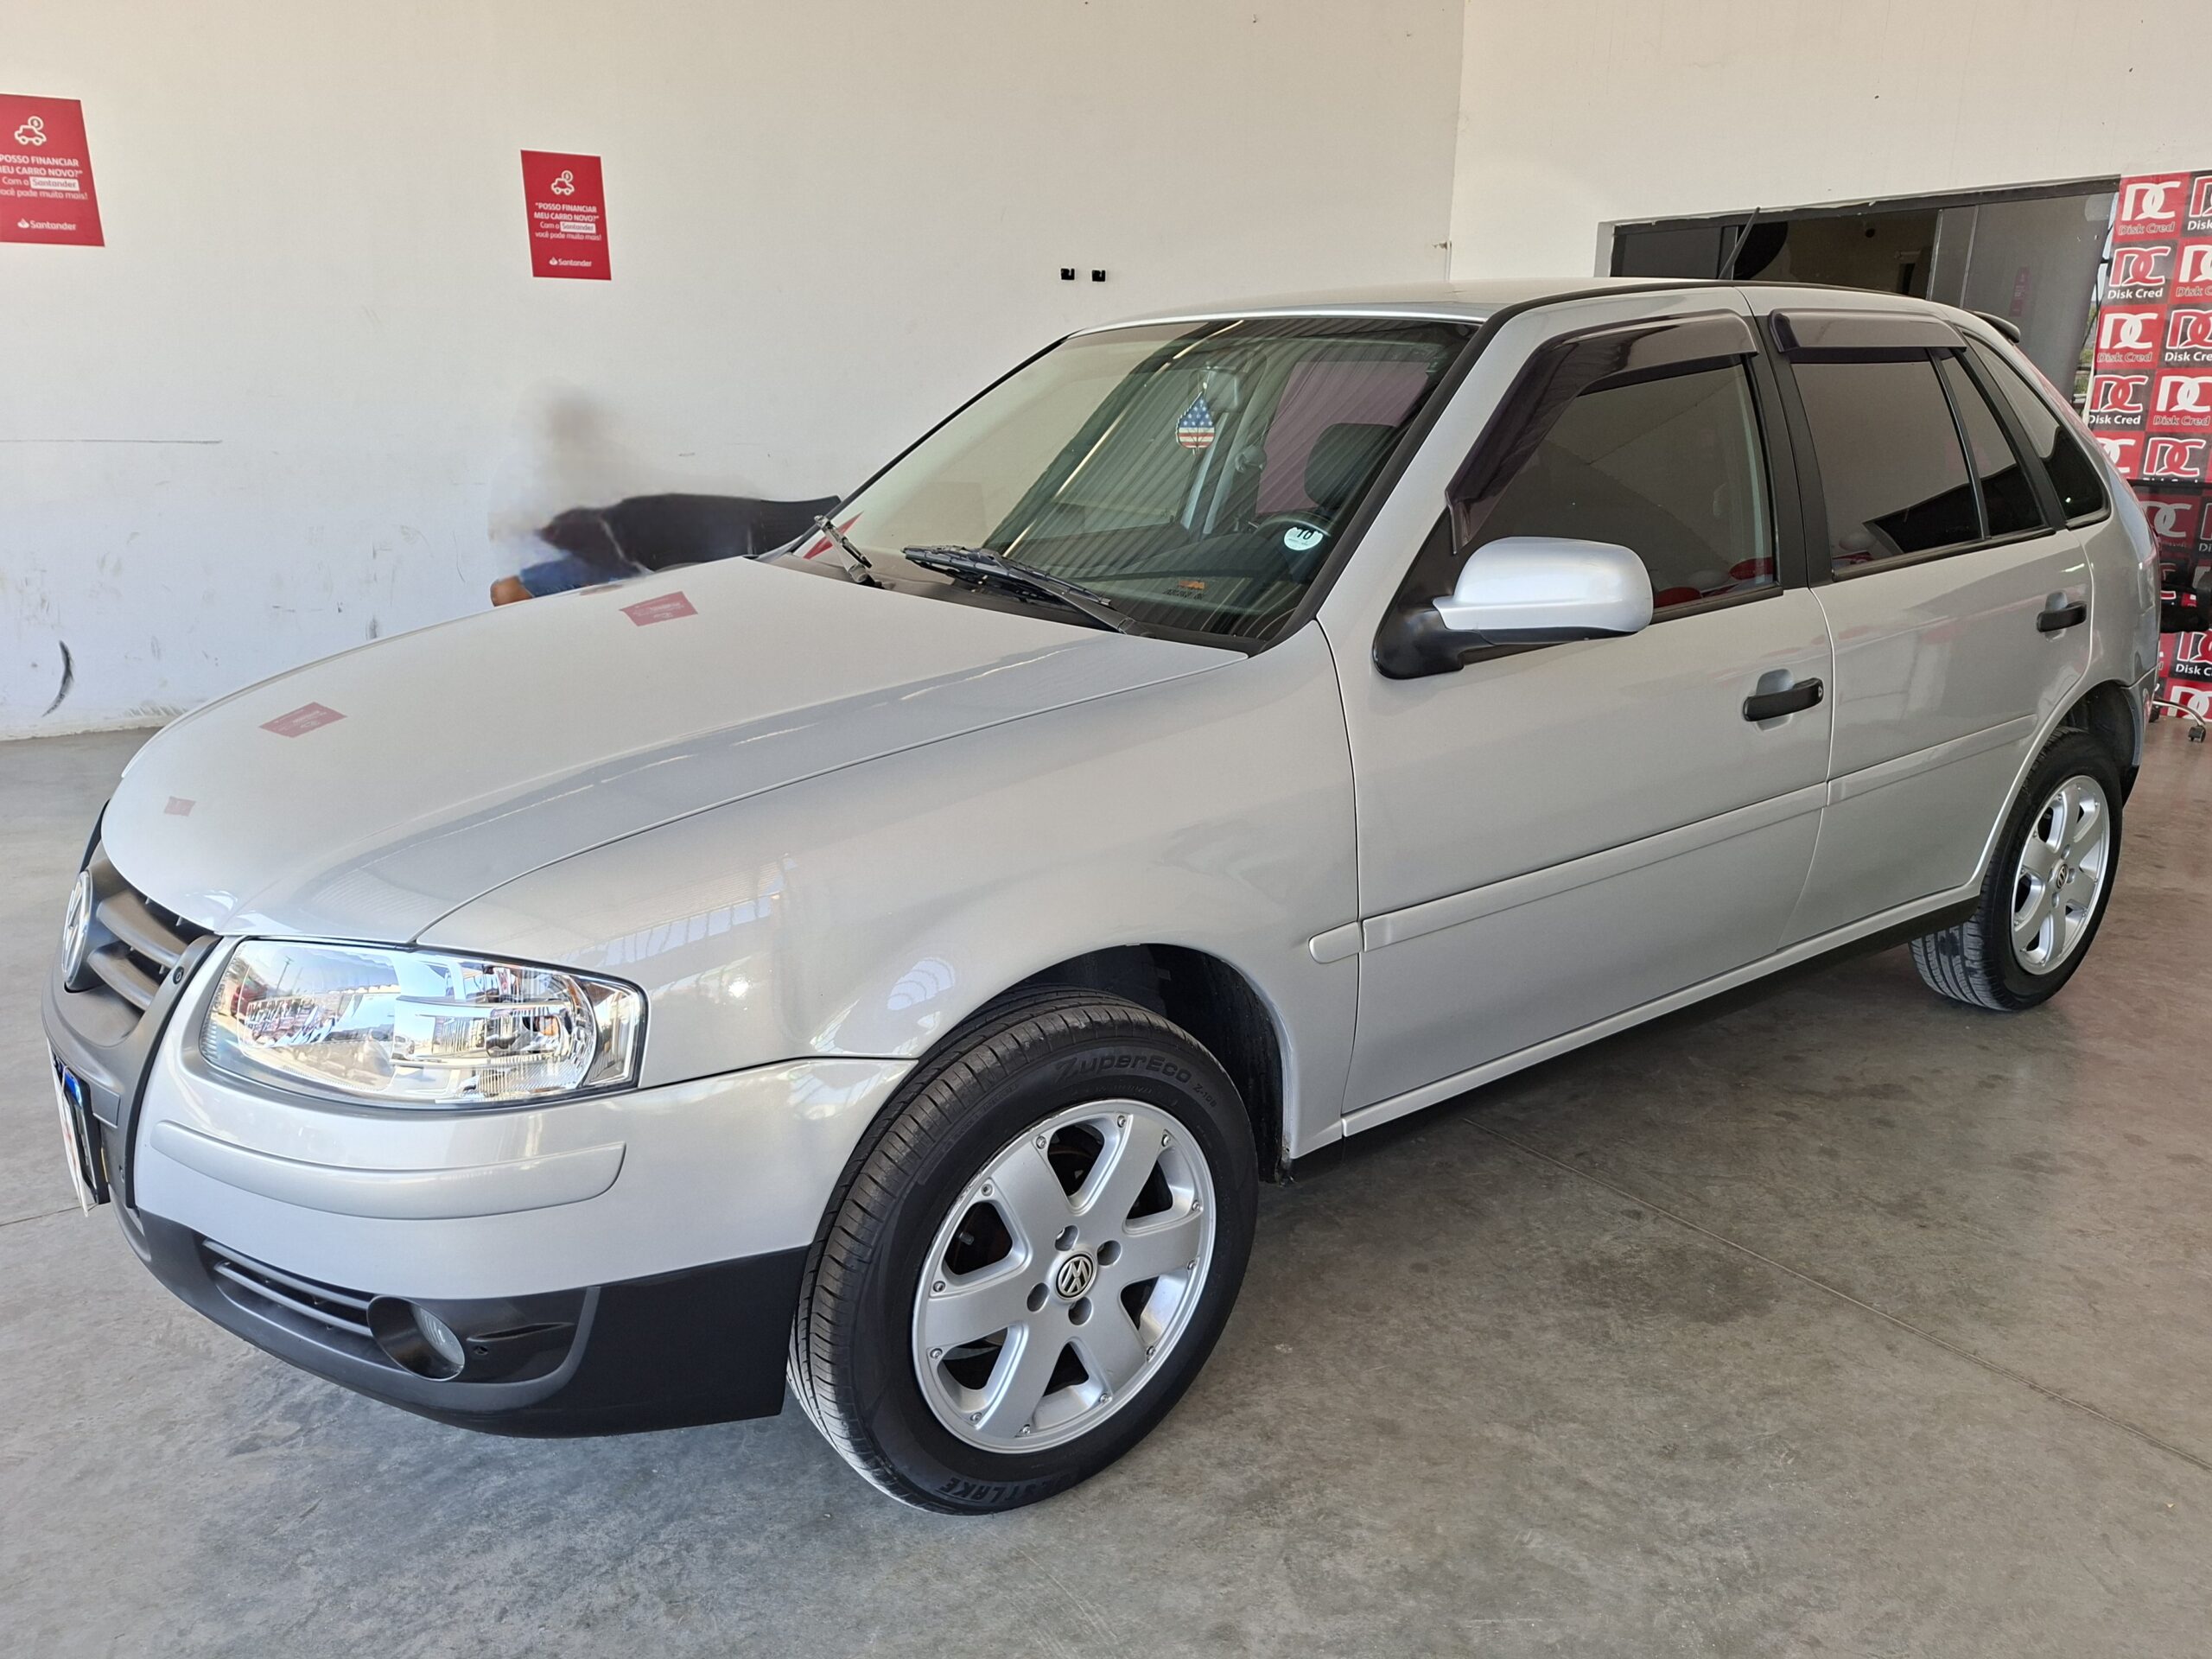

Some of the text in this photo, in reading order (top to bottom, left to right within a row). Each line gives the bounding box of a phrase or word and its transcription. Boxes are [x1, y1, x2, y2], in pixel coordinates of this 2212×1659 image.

[30, 156, 79, 167] FINANCIAR
[16, 167, 47, 176] CARRO
[2, 176, 22, 185] Com
[33, 178, 78, 188] Santander
[16, 188, 38, 198] pode
[40, 190, 64, 199] muito
[30, 219, 77, 230] Santander
[562, 222, 594, 231] Santander
[2119, 221, 2176, 236] Disk Cred
[2107, 288, 2164, 300] Disk Cred
[2176, 286, 2203, 297] Disk
[2097, 351, 2153, 363] Disk Cred
[2165, 351, 2212, 362] Disk Cre
[2113, 415, 2141, 425] Cred
[2153, 416, 2211, 426] Disk Cred
[2175, 664, 2201, 675] Disk
